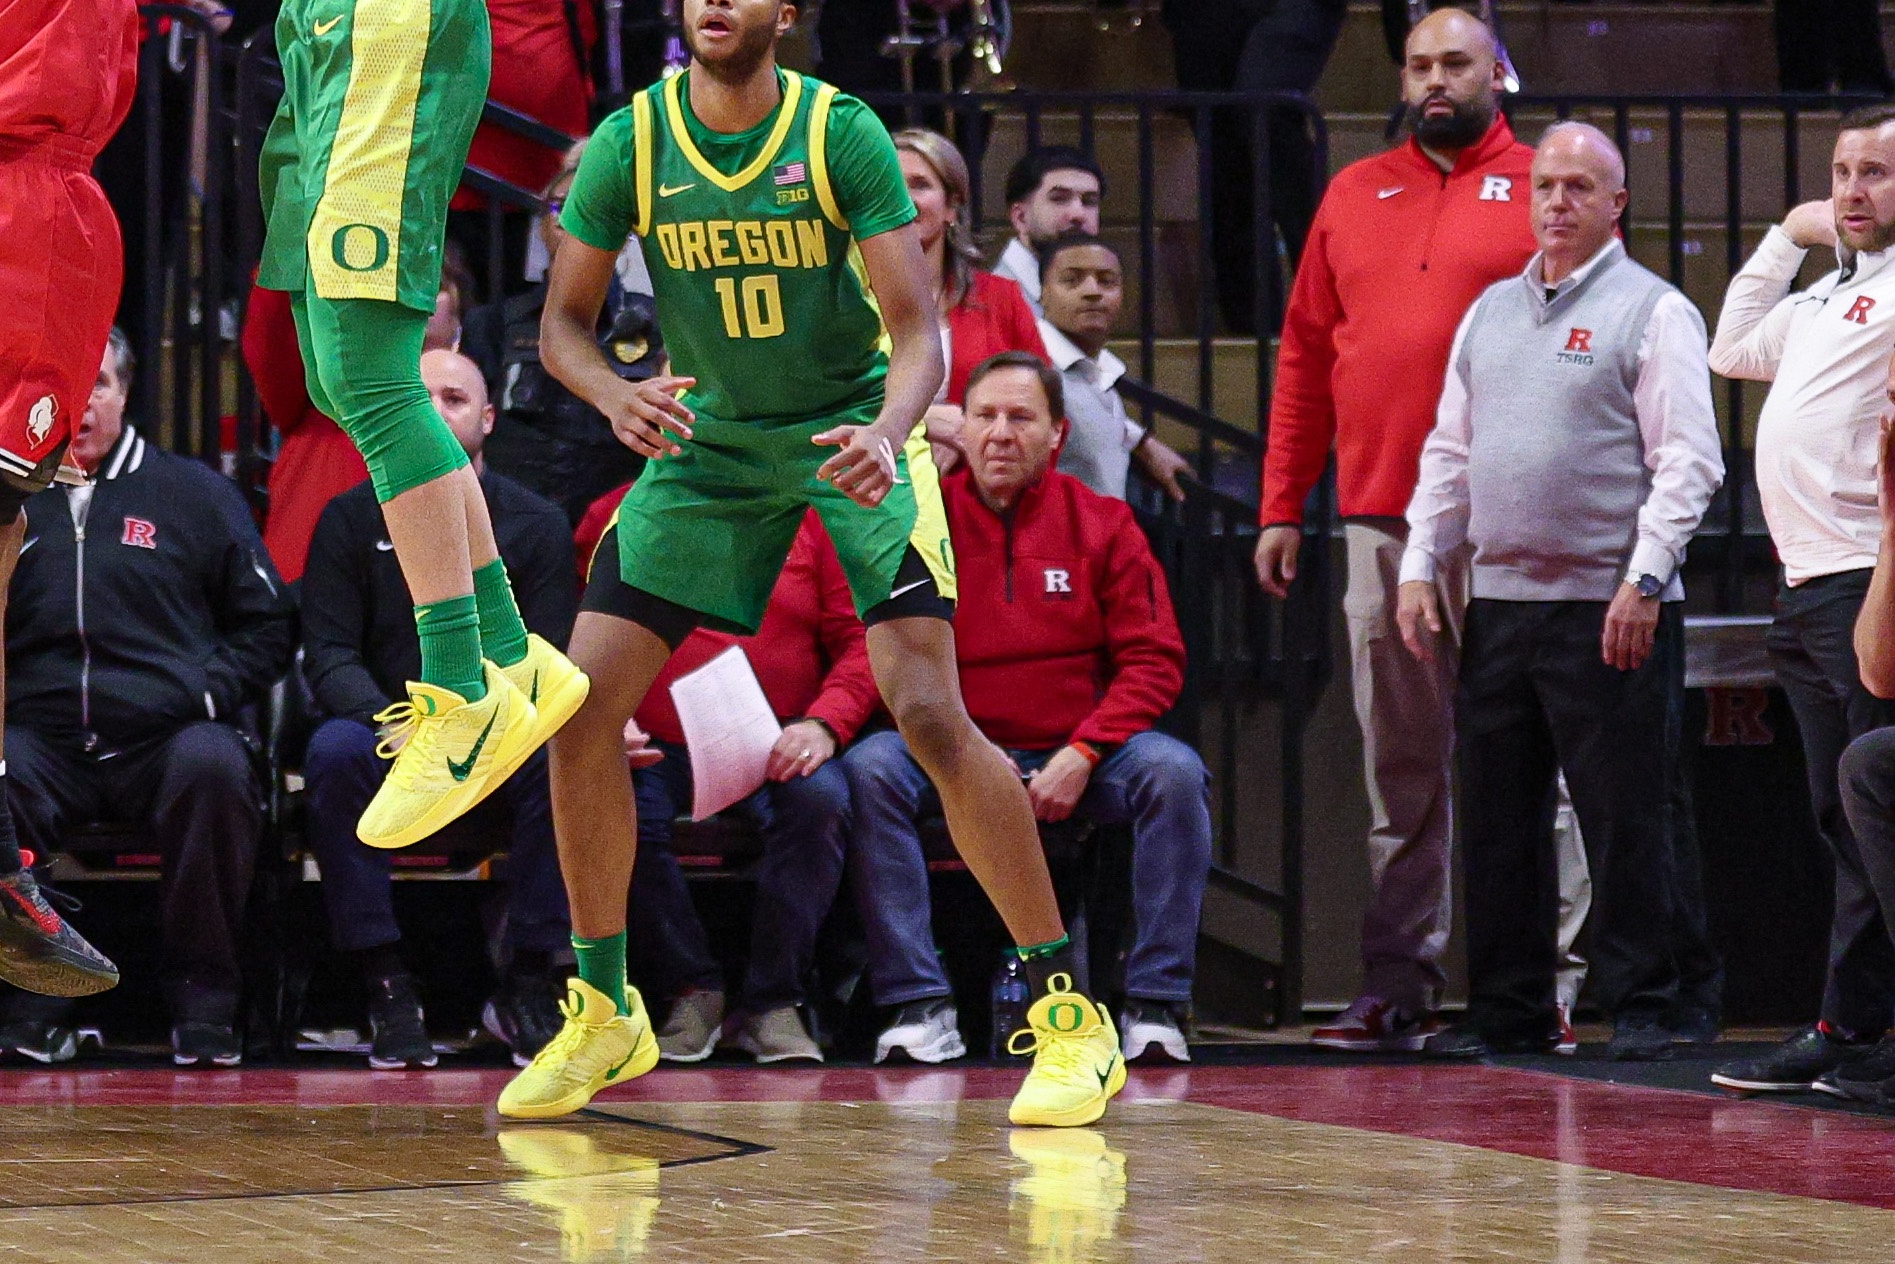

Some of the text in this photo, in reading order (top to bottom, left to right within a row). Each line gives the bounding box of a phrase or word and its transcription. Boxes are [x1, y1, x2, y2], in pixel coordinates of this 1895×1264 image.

[1479, 174, 1512, 202] R
[331, 223, 389, 272] O
[655, 218, 830, 272] OREGON
[715, 274, 786, 339] 10
[1842, 295, 1876, 324] R
[1565, 327, 1593, 353] R
[121, 517, 157, 550] R
[1044, 569, 1072, 592] R
[1705, 686, 1775, 746] R
[1049, 1003, 1083, 1032] O
